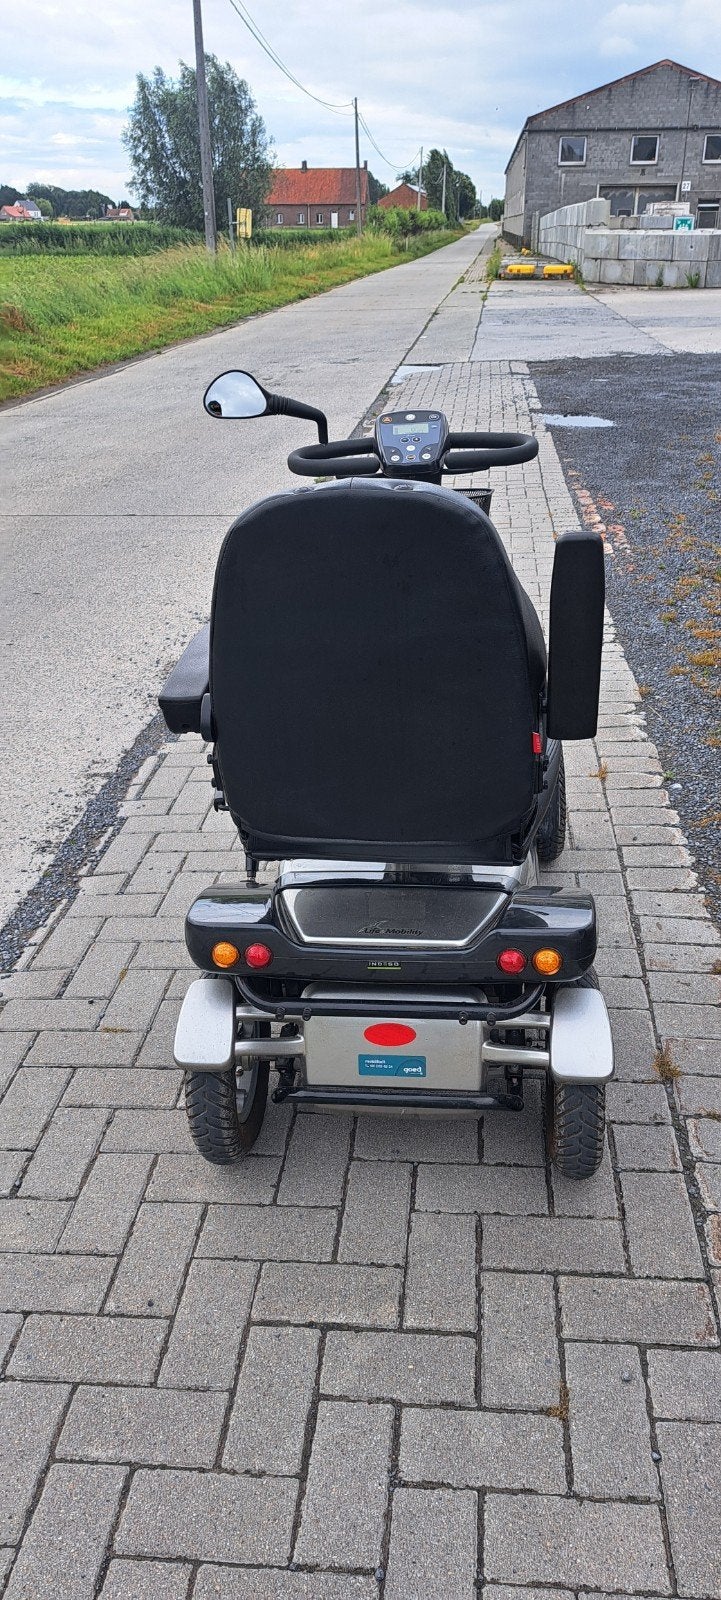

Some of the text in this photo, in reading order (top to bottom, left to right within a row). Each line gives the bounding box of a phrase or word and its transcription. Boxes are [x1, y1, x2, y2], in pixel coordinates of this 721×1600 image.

[682, 182, 690, 190] 27
[363, 927, 381, 936] Life
[385, 928, 424, 936] Mobility
[403, 1066, 422, 1074] goed
